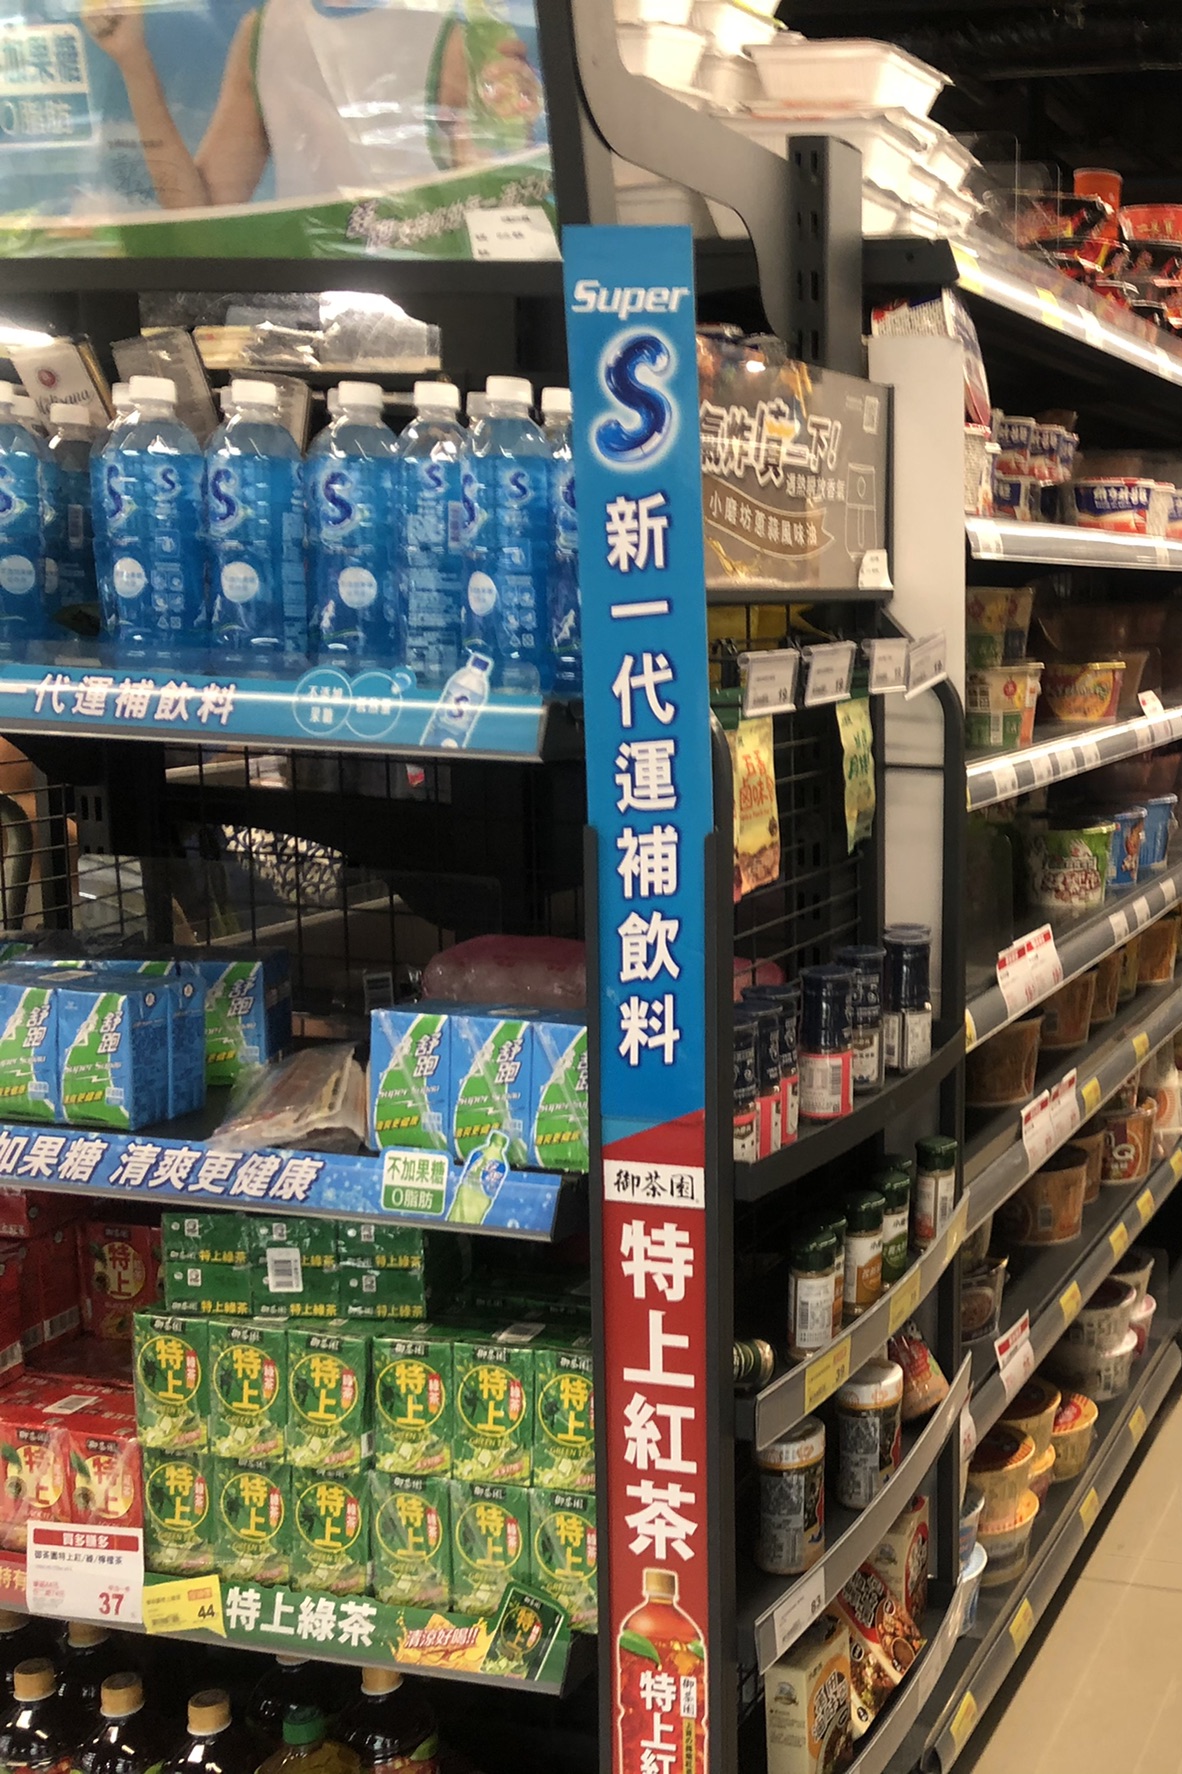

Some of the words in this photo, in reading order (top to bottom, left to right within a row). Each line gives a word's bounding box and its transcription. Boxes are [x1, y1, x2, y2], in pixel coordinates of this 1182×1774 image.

[571, 279, 690, 320] Super
[605, 492, 681, 1066] 新一代運補飲料
[22, 1004, 50, 1048] 舒跑
[226, 976, 256, 1018] 舒跑
[96, 1010, 124, 1054] 舒跑
[413, 1032, 442, 1077] 舒跑
[494, 1037, 524, 1084] 舒跑
[0, 1131, 108, 1183] 加果糖
[109, 1142, 325, 1201] 清爽更健康
[386, 1156, 446, 1188] 不加果糖
[613, 1168, 698, 1203] 御茶園
[391, 1187, 434, 1210] 0脂肪
[108, 1243, 132, 1296] 特上
[156, 1339, 184, 1400] 特上
[232, 1348, 261, 1410] 特上
[307, 1357, 340, 1420] 特上
[395, 1363, 426, 1425] 特上
[476, 1368, 507, 1432] 特上
[619, 1219, 699, 1563] 特上紅茶
[557, 1377, 588, 1442] 特上
[164, 1464, 193, 1527] 特上
[240, 1475, 268, 1537] 特上
[314, 1484, 345, 1548] 特上
[396, 1497, 426, 1557] 特上
[476, 1506, 505, 1567] 特上
[555, 1514, 584, 1577] 特上
[99, 1592, 124, 1616] 37
[198, 1604, 215, 1619] 44
[225, 1586, 377, 1648] 特上綠茶
[639, 1669, 677, 1774] 特上紅
